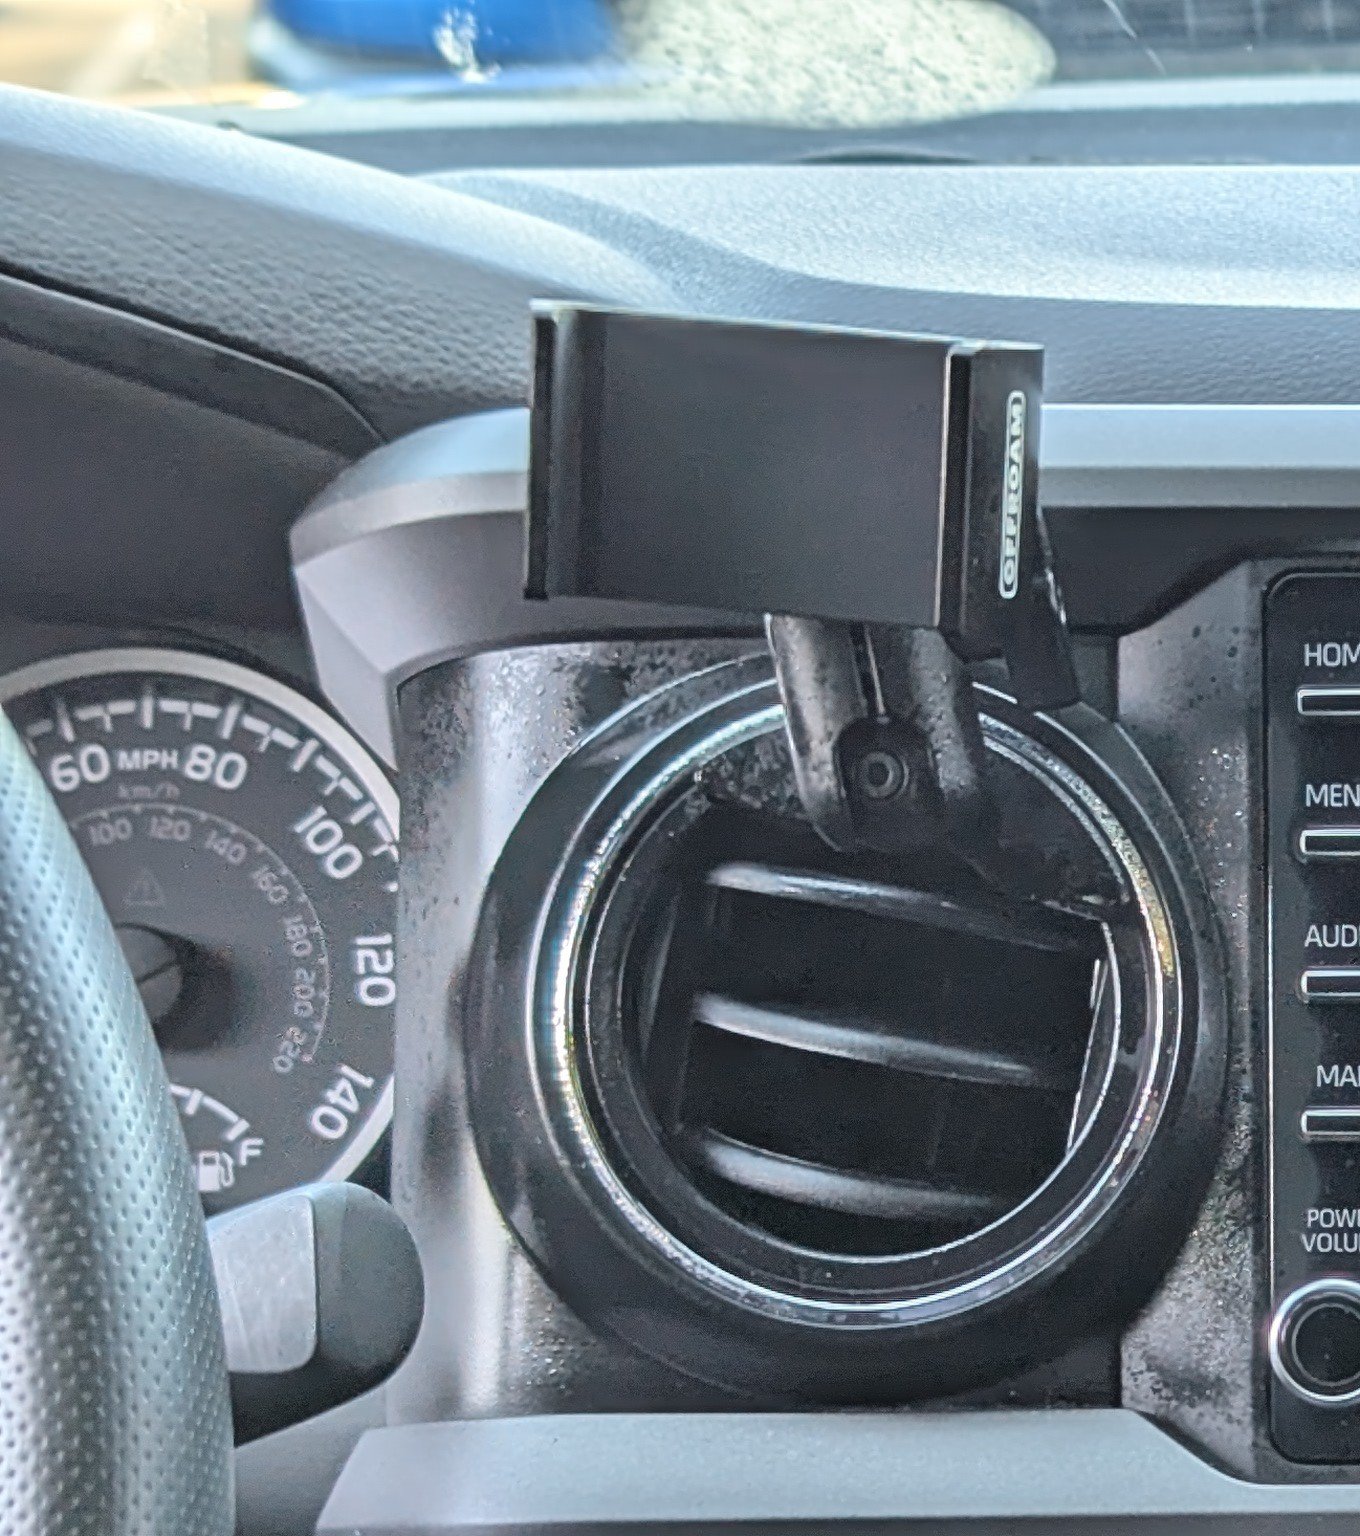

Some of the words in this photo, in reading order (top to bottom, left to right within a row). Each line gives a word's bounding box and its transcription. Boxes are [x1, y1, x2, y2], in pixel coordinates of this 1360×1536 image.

[50, 745, 110, 791] 60
[117, 749, 178, 771] MPH
[183, 745, 248, 789] 80
[118, 783, 180, 799] km/h
[89, 817, 132, 846] 100
[150, 815, 191, 841] 120
[295, 806, 362, 880] 100
[205, 830, 247, 865] 140
[254, 865, 289, 904] 160
[355, 934, 395, 1007] 120
[311, 1062, 375, 1139] 140
[239, 1138, 264, 1165] F
